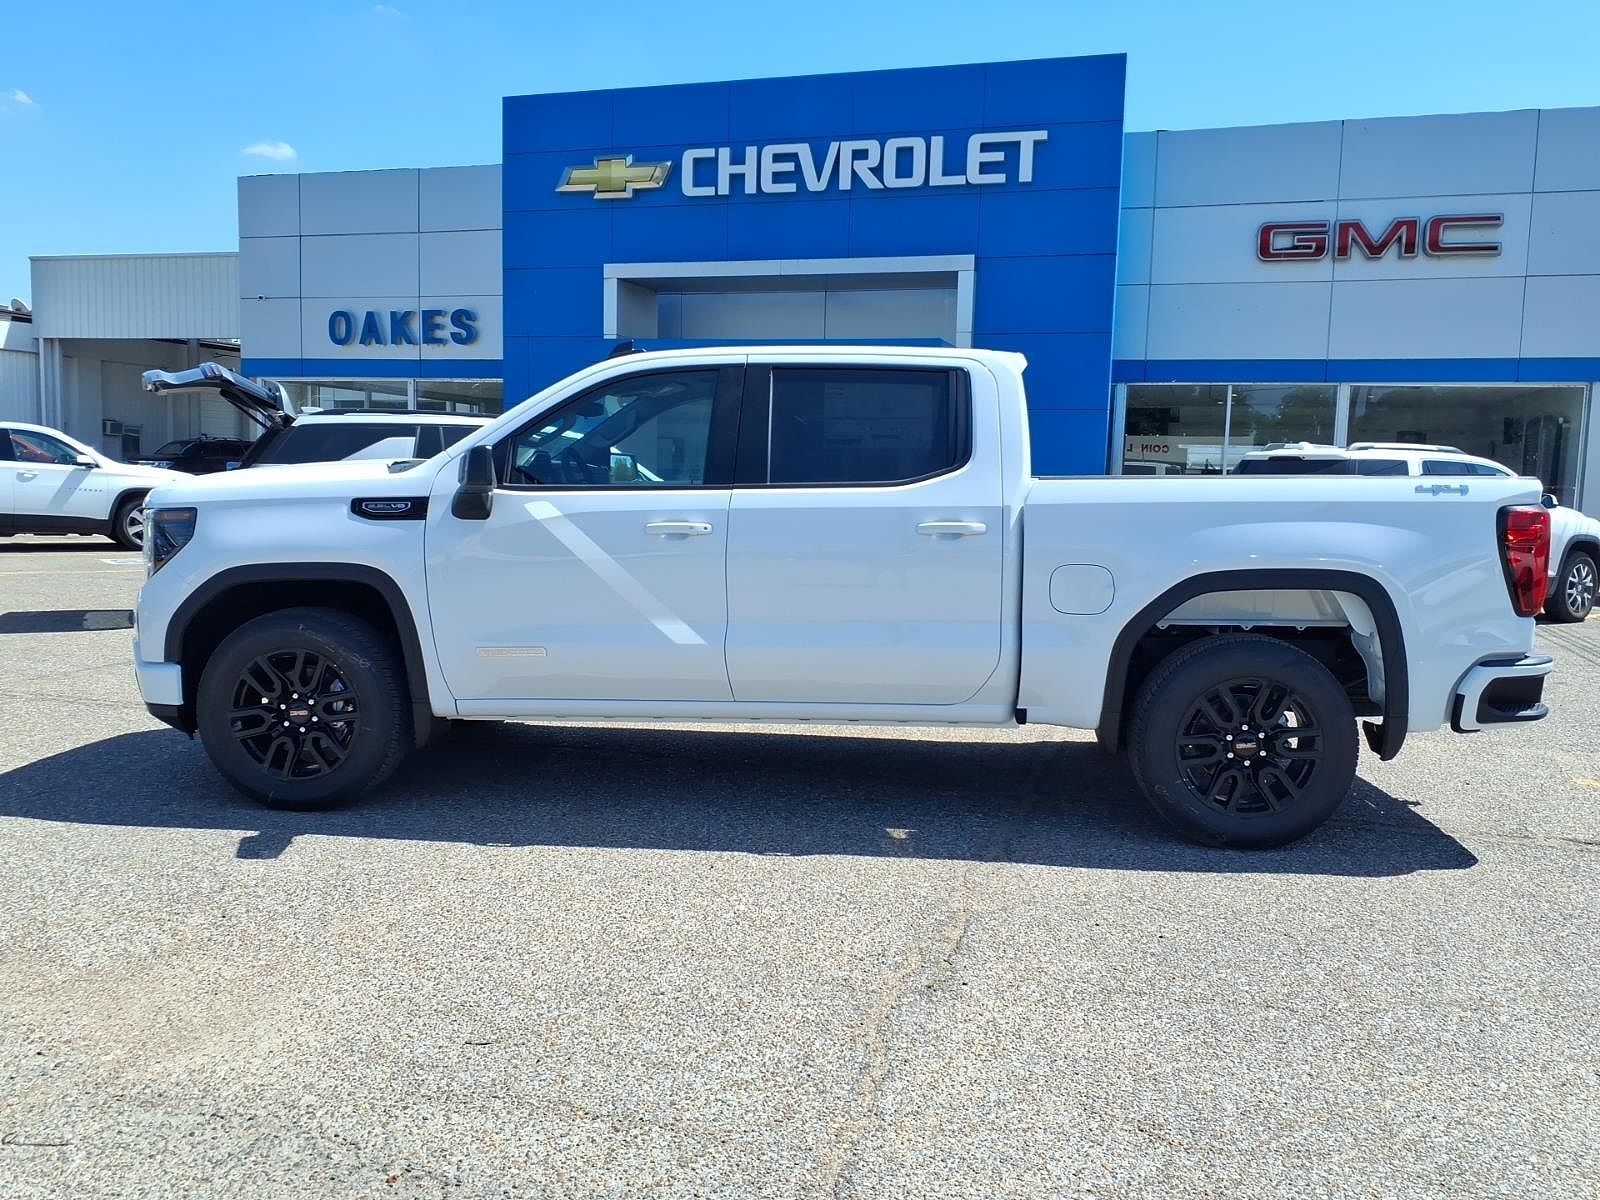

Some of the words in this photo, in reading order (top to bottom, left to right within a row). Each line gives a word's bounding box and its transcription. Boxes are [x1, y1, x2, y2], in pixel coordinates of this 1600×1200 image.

[680, 130, 1048, 197] CHEVROLET
[1256, 212, 1504, 262] GMC
[328, 308, 479, 346] OAKES
